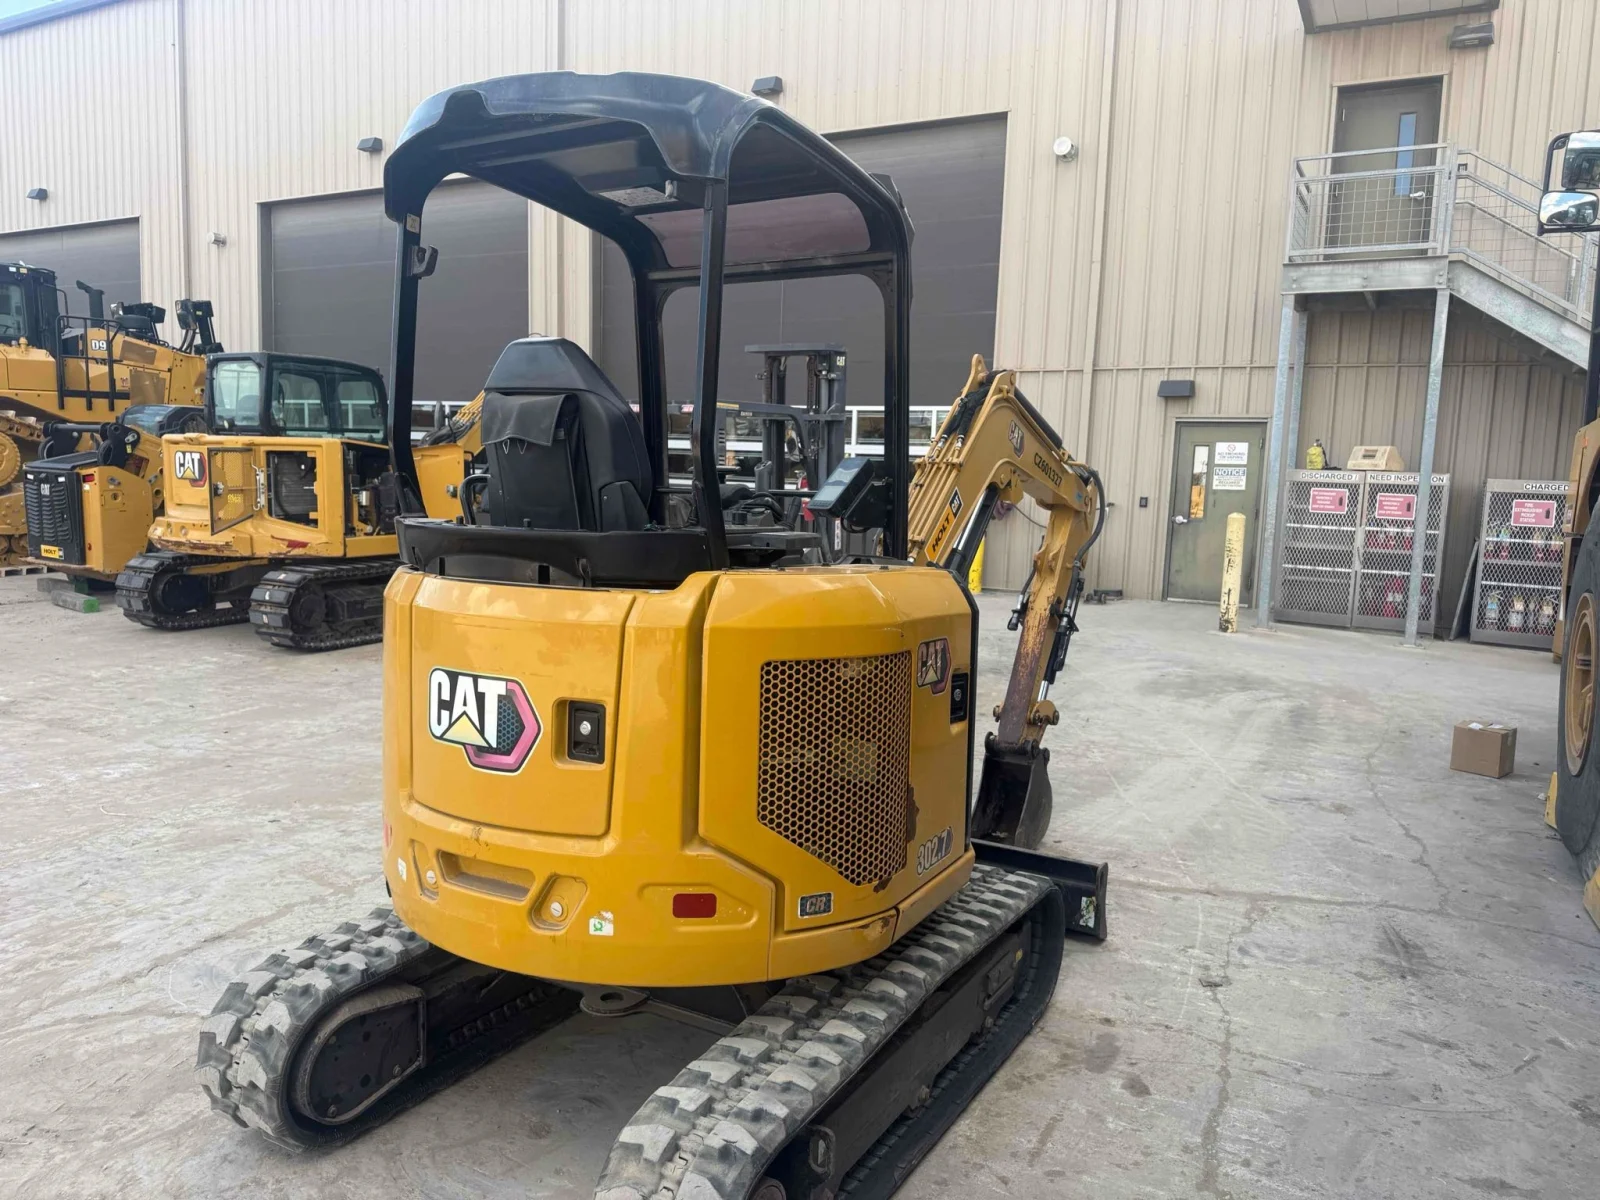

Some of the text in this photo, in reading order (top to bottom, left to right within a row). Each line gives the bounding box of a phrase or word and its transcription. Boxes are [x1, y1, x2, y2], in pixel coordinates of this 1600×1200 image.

[91, 340, 107, 350] D9
[836, 356, 846, 366] CAT
[1008, 420, 1024, 450] CAT
[175, 451, 200, 479] CAT
[1034, 452, 1063, 487] CZ601327
[1215, 468, 1245, 476] NOTICE
[1301, 472, 1353, 481] DISCHARGED
[1394, 475, 1445, 483] INSPEON
[1524, 483, 1569, 491] CHARGED
[40, 483, 50, 495] CAT
[932, 495, 960, 552] HOLT CAT
[918, 640, 944, 686] CAT
[429, 669, 507, 748] CAT
[917, 828, 949, 875] 302.7
[806, 897, 826, 913] CR
